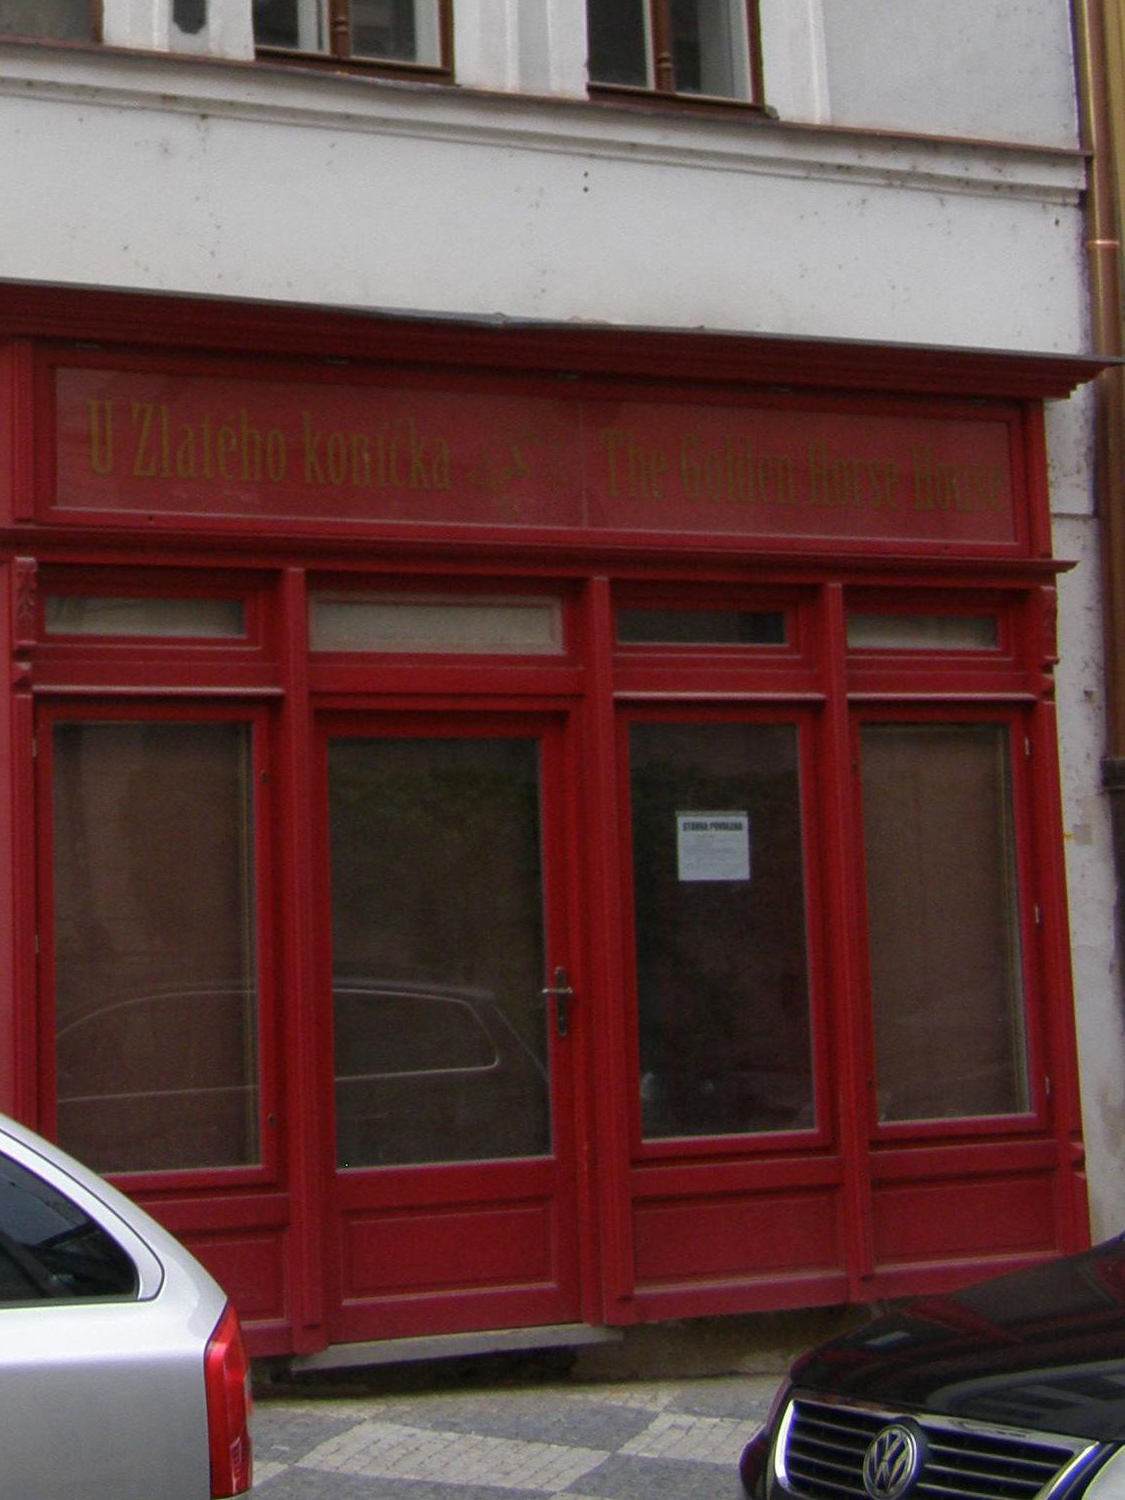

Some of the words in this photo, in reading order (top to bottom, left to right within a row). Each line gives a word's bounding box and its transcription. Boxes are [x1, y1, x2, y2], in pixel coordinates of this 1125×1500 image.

[87, 400, 113, 475] U
[132, 403, 286, 483] Zlatého
[601, 427, 667, 500] The
[680, 432, 798, 505] Golden
